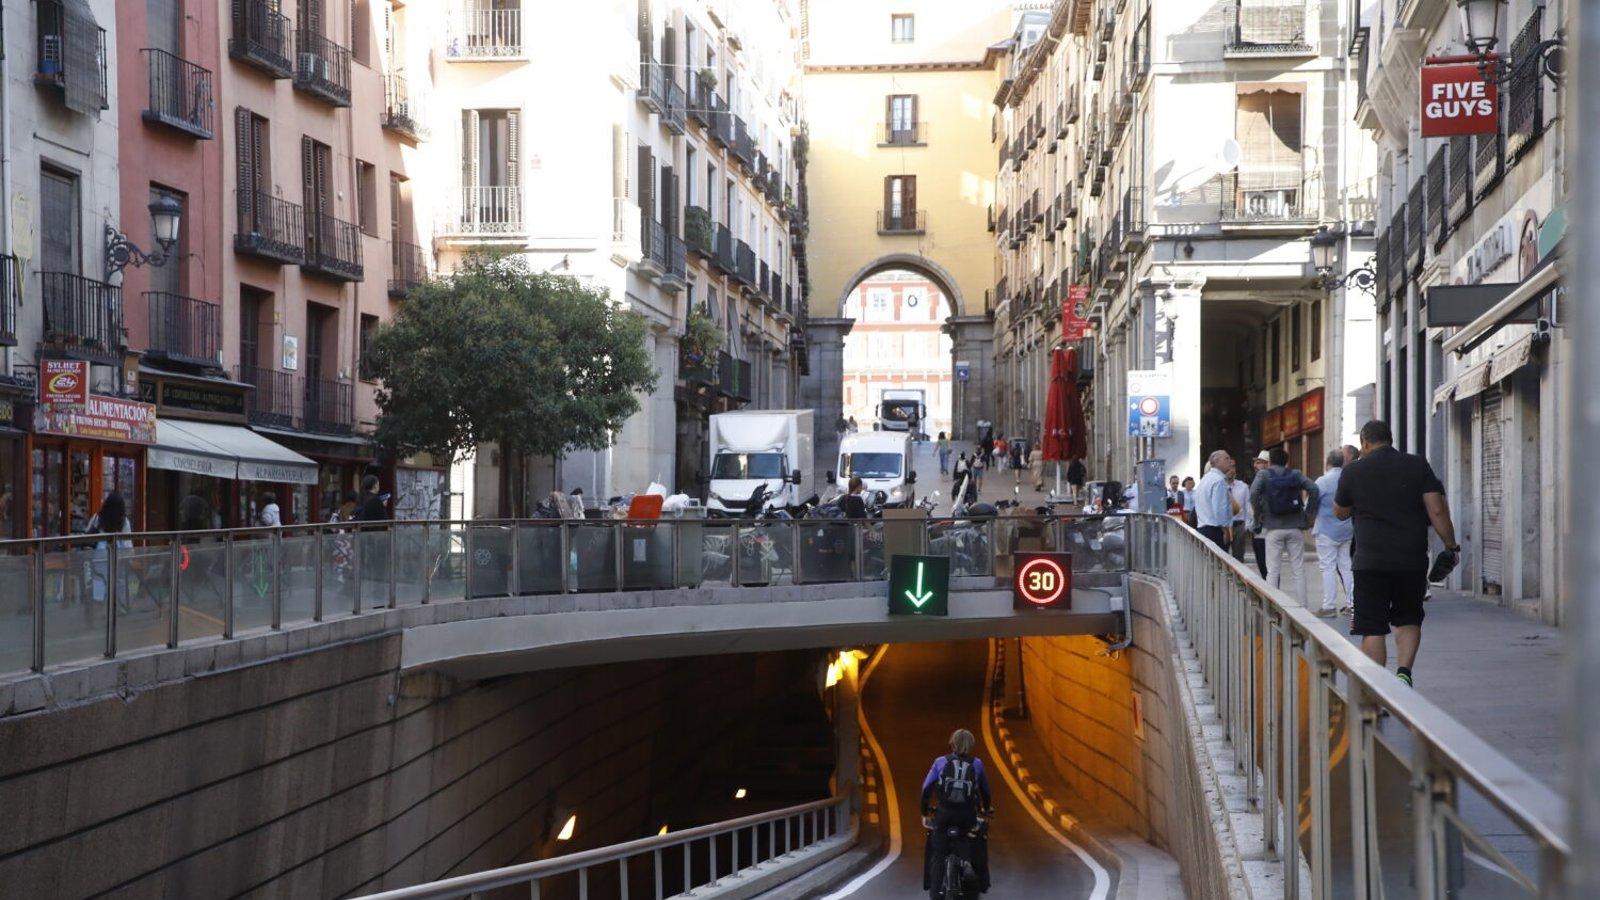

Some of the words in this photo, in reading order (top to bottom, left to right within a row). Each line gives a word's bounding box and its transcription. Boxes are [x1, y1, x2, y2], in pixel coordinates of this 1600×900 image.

[1432, 81, 1486, 100] FIVE
[1425, 99, 1493, 119] GUYS
[48, 361, 80, 369] SYLHET
[54, 376, 76, 387] 24
[89, 399, 147, 421] ALIMENTACIÓN
[1029, 571, 1055, 591] 30
